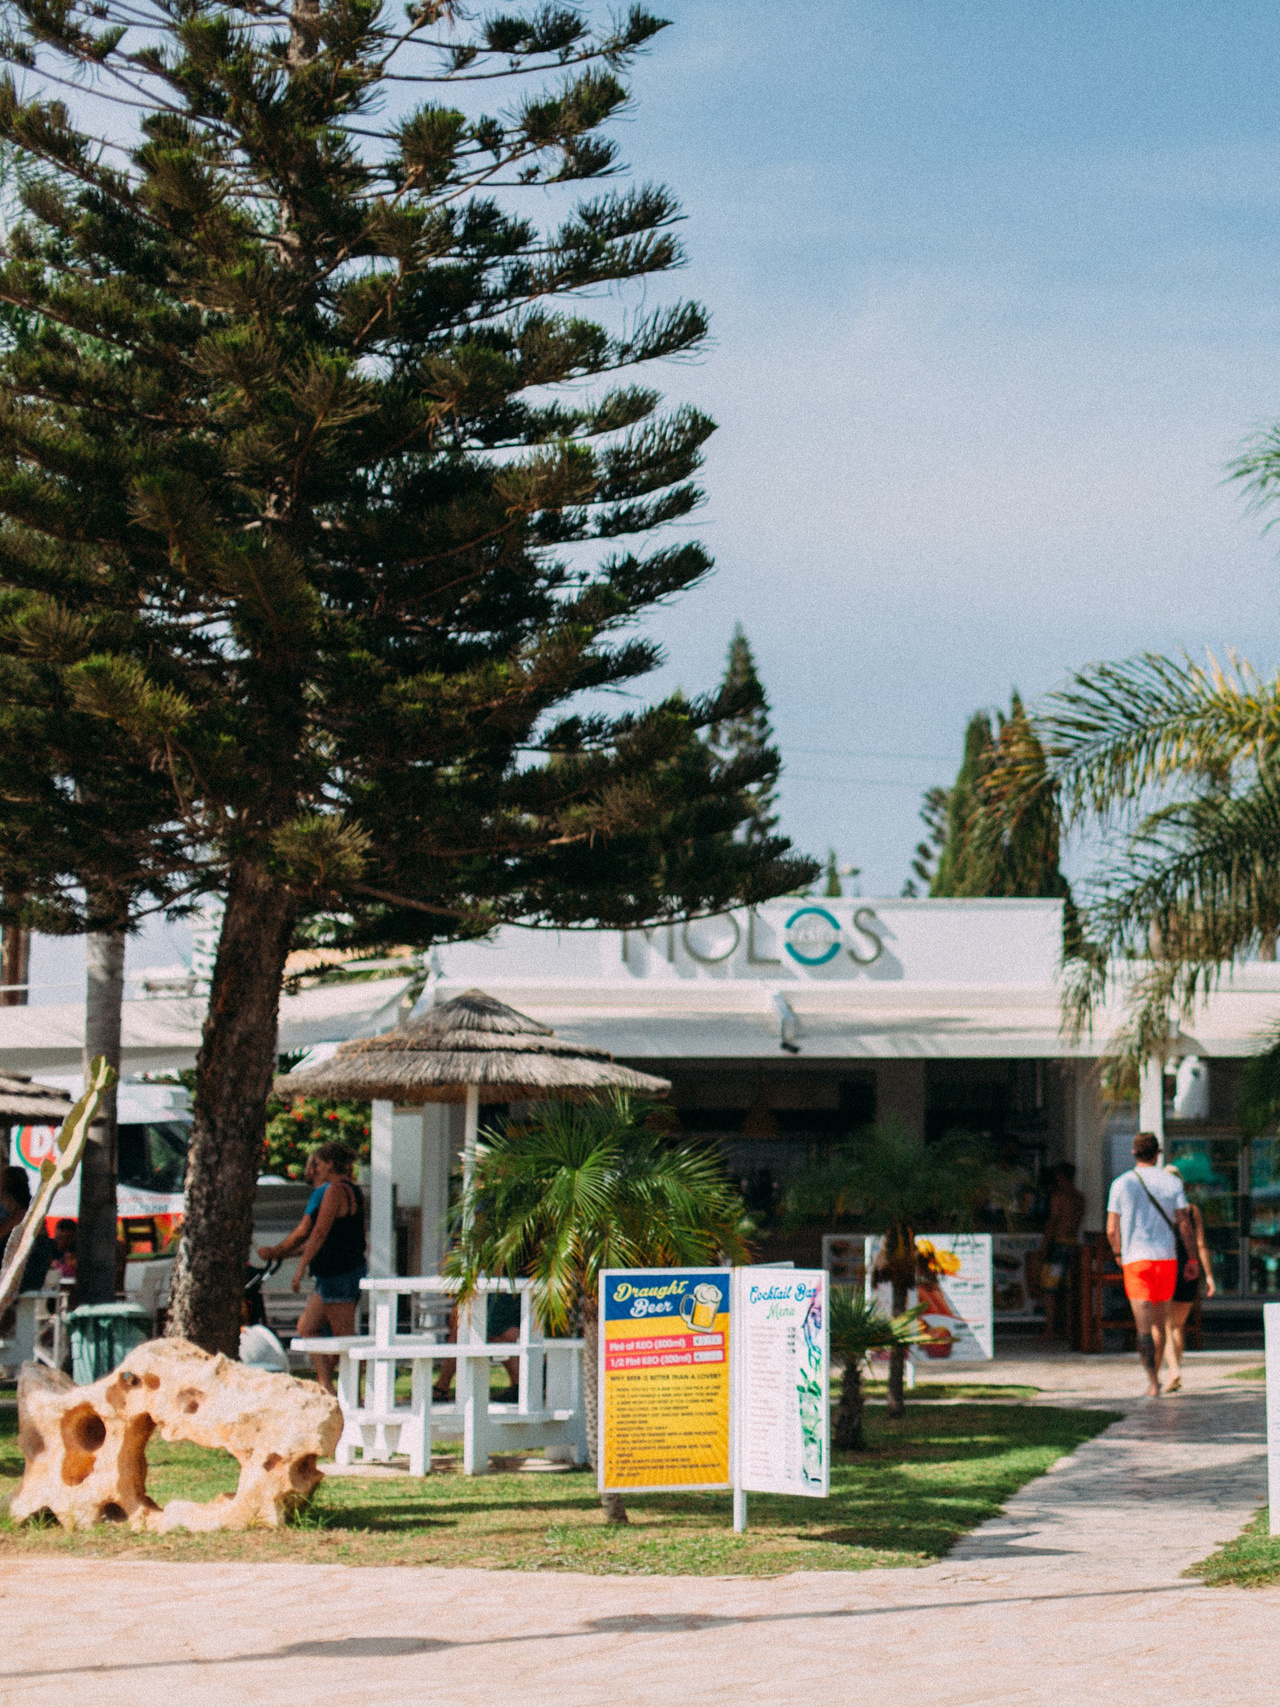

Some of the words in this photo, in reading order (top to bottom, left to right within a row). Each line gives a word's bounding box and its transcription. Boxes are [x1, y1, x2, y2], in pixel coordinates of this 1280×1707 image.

[613, 1280, 689, 1302] Draught
[749, 1285, 793, 1304] Cocktail
[794, 1282, 818, 1302] Bar
[630, 1298, 673, 1318] Beer
[766, 1302, 796, 1320] Menu
